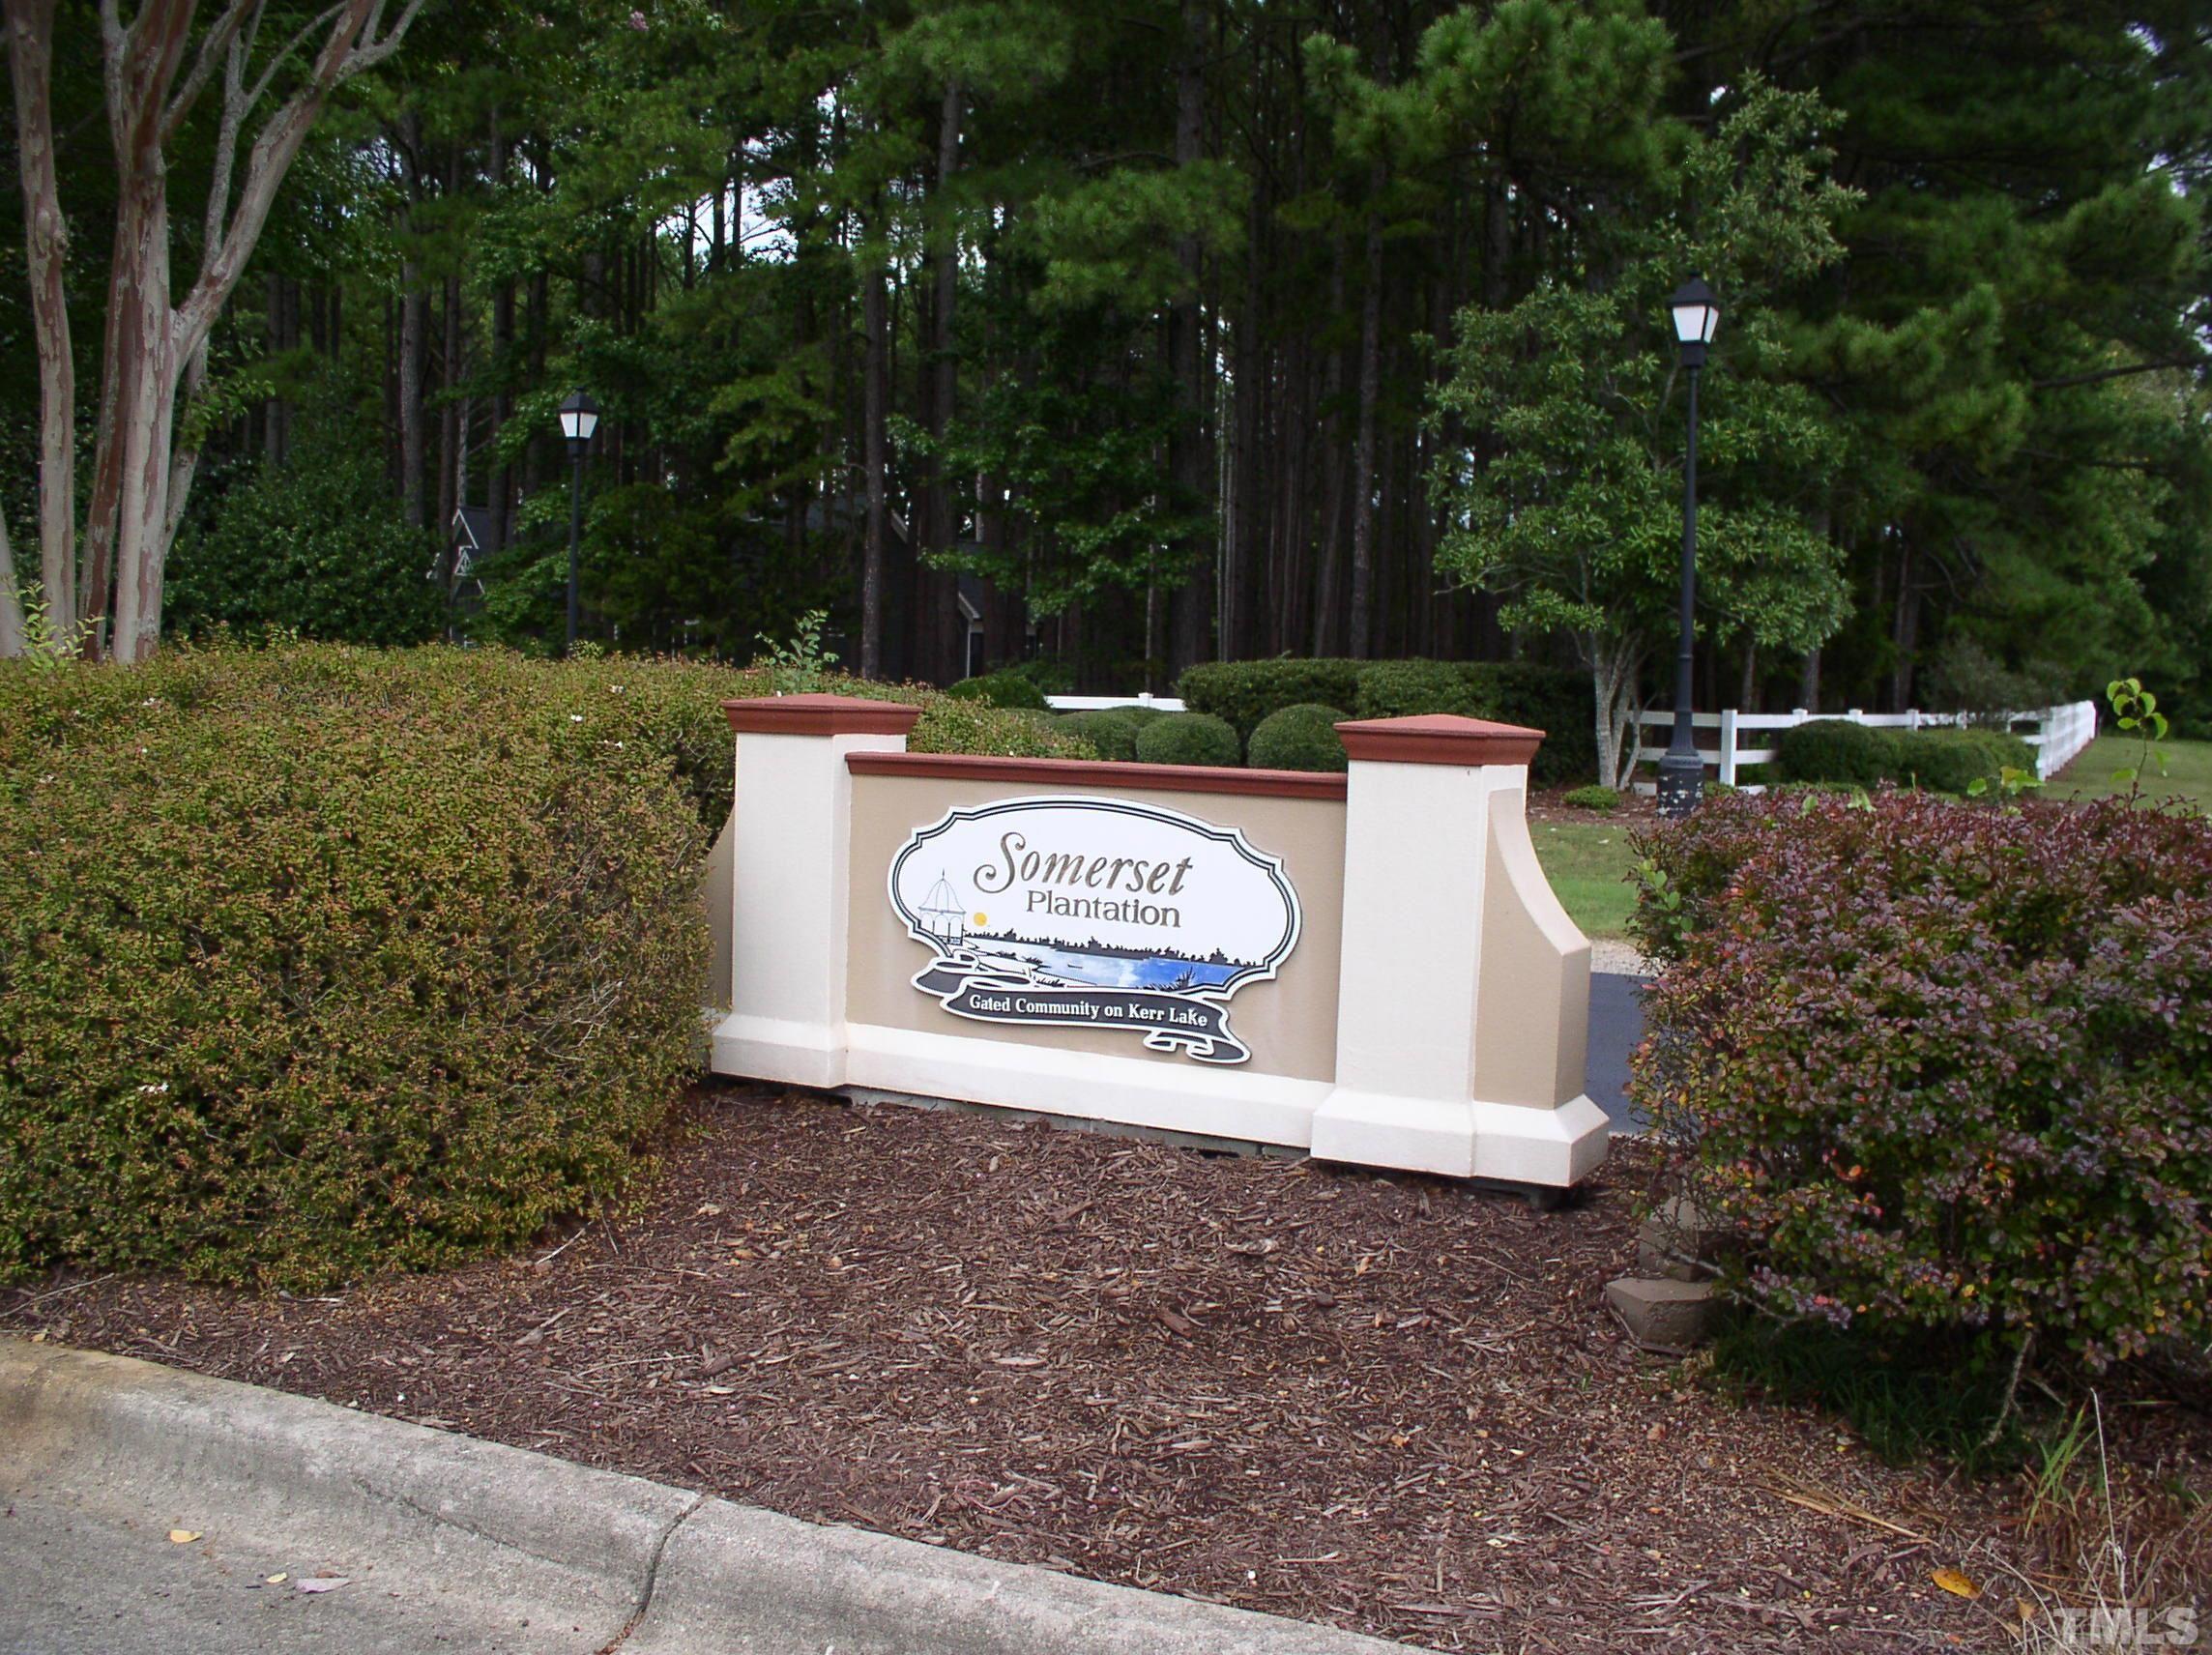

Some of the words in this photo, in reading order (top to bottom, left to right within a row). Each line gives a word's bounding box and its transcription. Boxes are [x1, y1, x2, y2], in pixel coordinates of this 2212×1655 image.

[974, 831, 1193, 896] Somerset
[1026, 889, 1181, 928] Plantation
[969, 994, 1010, 1012] Gated
[1015, 998, 1099, 1020] Community
[1104, 1004, 1123, 1018] on
[1128, 1003, 1165, 1022] Kerr
[1169, 1007, 1208, 1028] Lake
